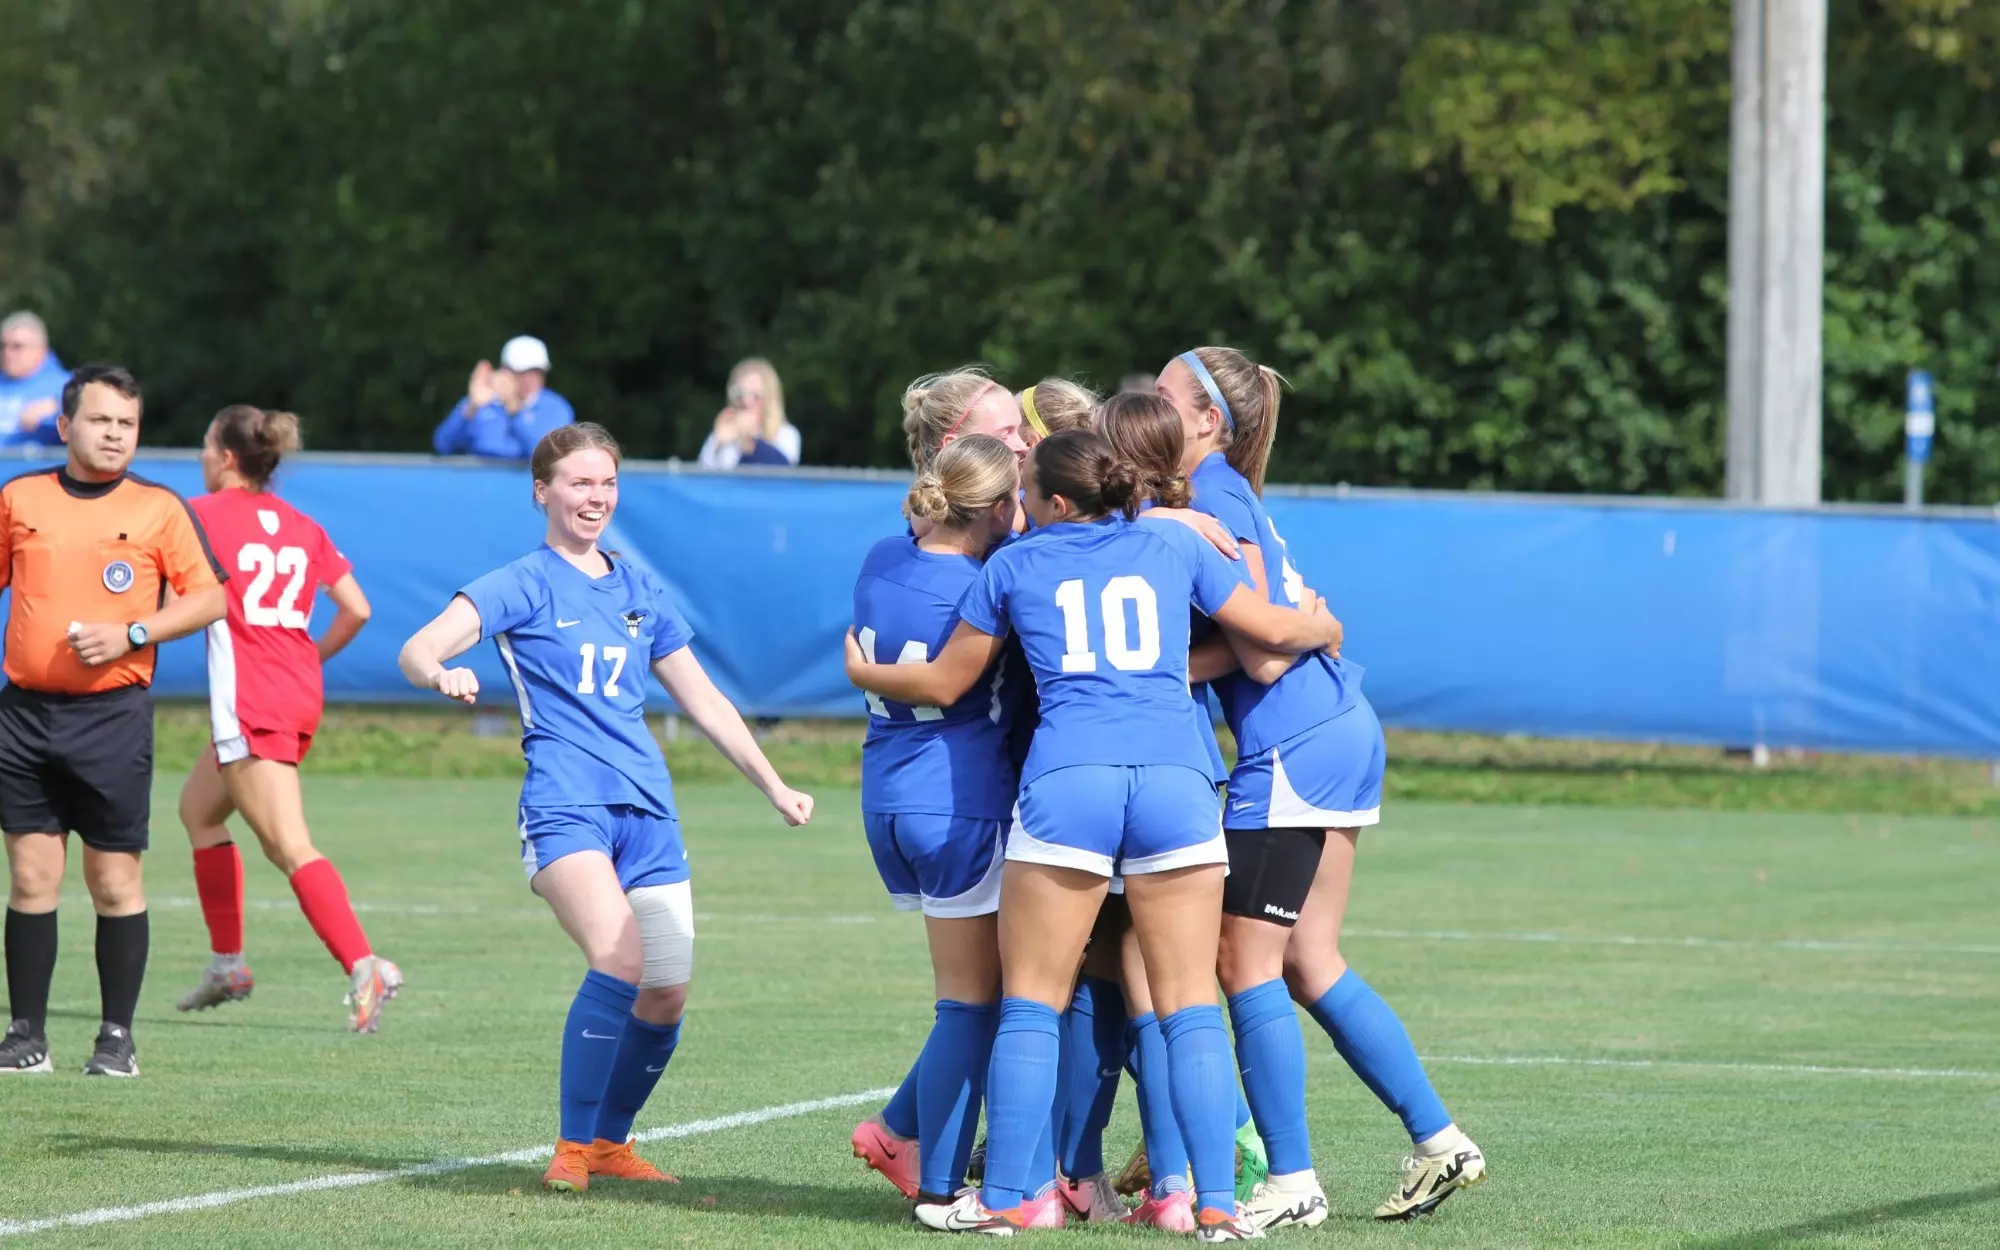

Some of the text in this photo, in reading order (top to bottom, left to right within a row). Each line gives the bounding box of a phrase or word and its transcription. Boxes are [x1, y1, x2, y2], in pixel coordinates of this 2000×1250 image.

[237, 542, 309, 629] 22
[1055, 575, 1161, 673] 10
[577, 643, 627, 697] 17
